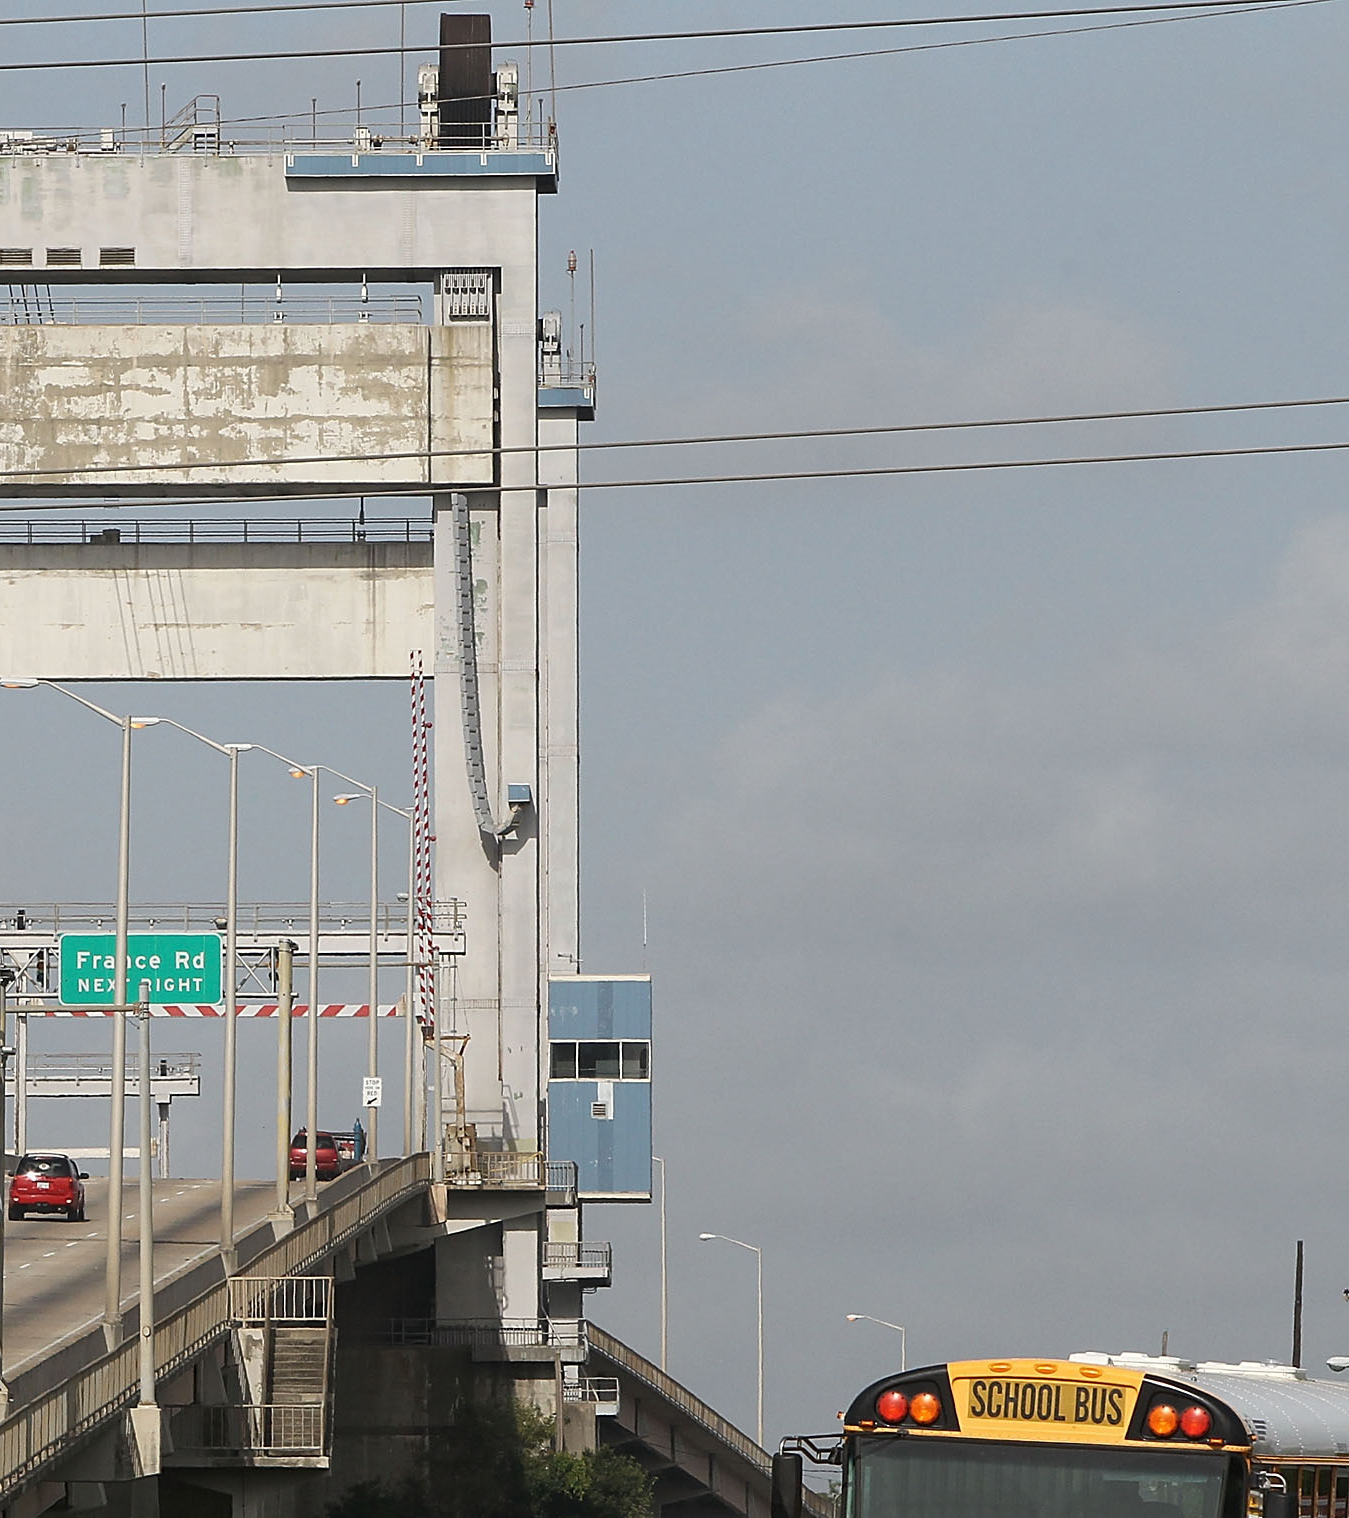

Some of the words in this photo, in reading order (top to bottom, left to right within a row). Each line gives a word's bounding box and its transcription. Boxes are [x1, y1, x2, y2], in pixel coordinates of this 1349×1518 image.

[175, 951, 205, 969] Rd
[971, 1380, 1066, 1422] SCHOOL
[1074, 1386, 1123, 1425] BUS
